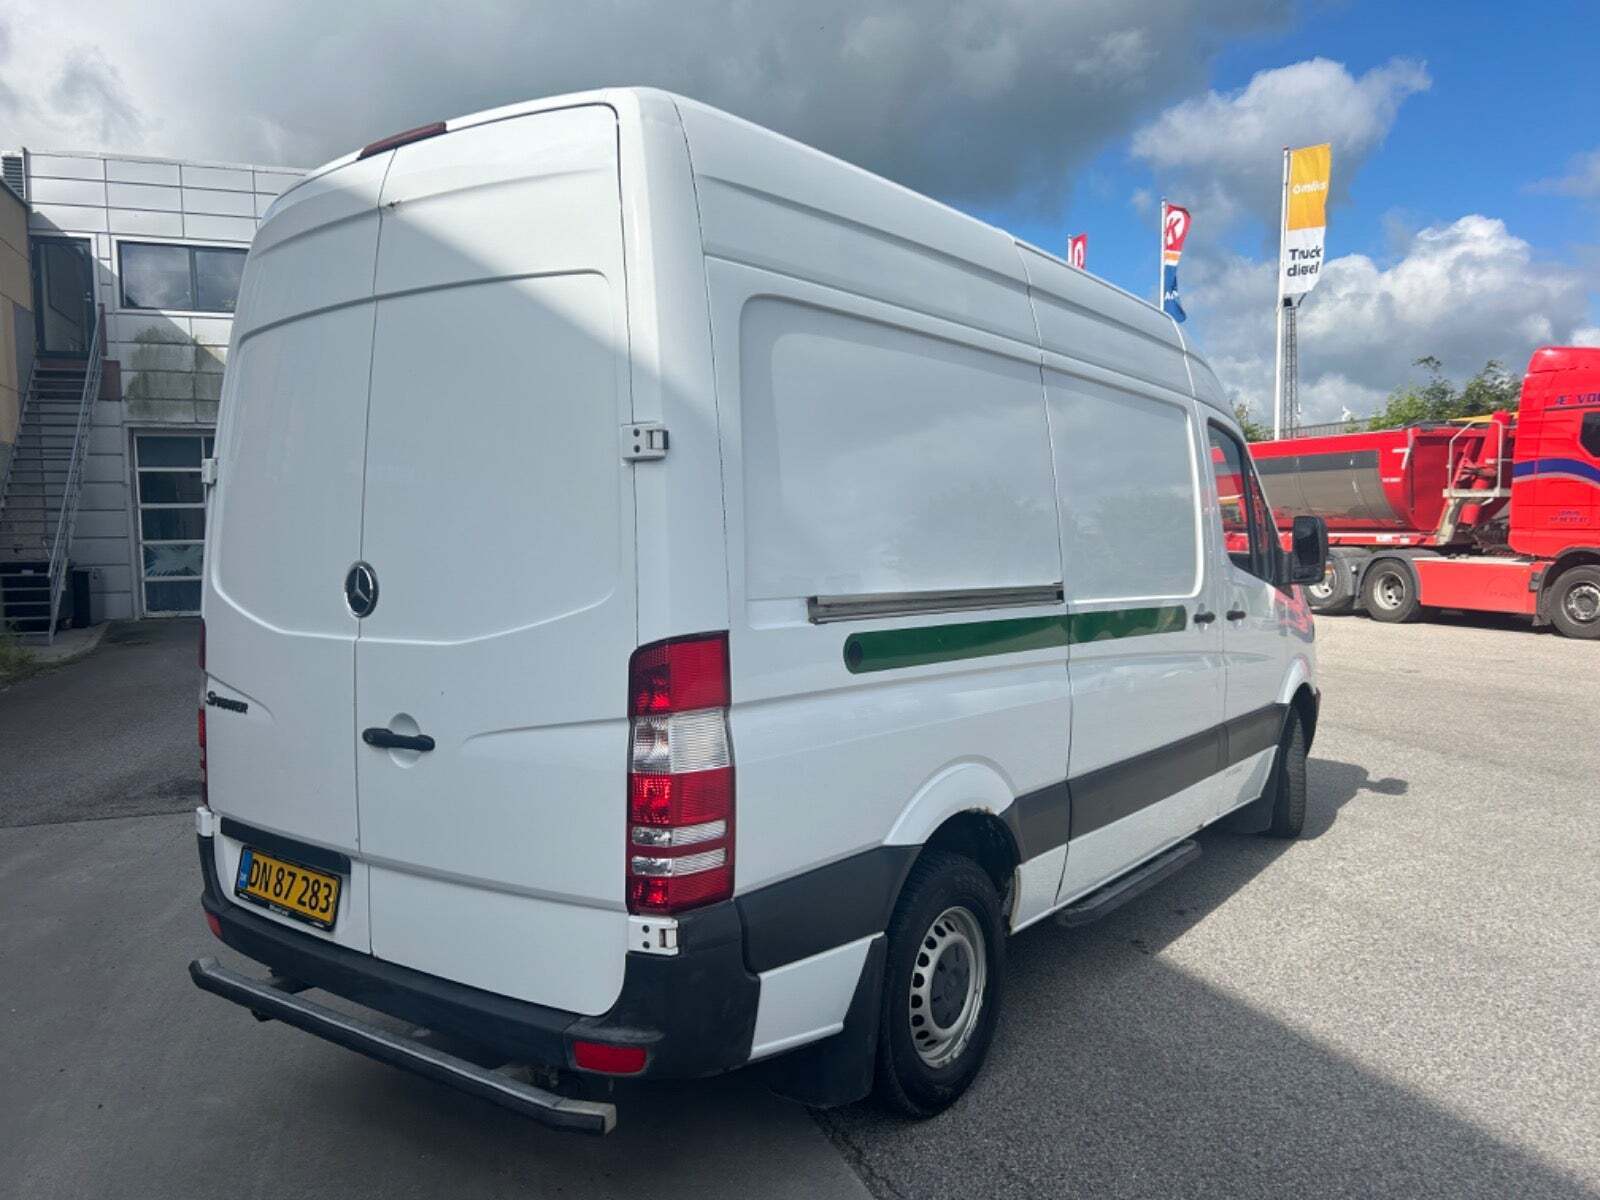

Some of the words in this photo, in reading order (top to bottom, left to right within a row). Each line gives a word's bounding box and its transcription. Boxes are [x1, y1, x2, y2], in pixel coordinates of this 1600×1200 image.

[1289, 246, 1321, 261] Truck
[249, 859, 272, 892] DN
[273, 867, 297, 900] 87
[297, 876, 332, 913] 283
